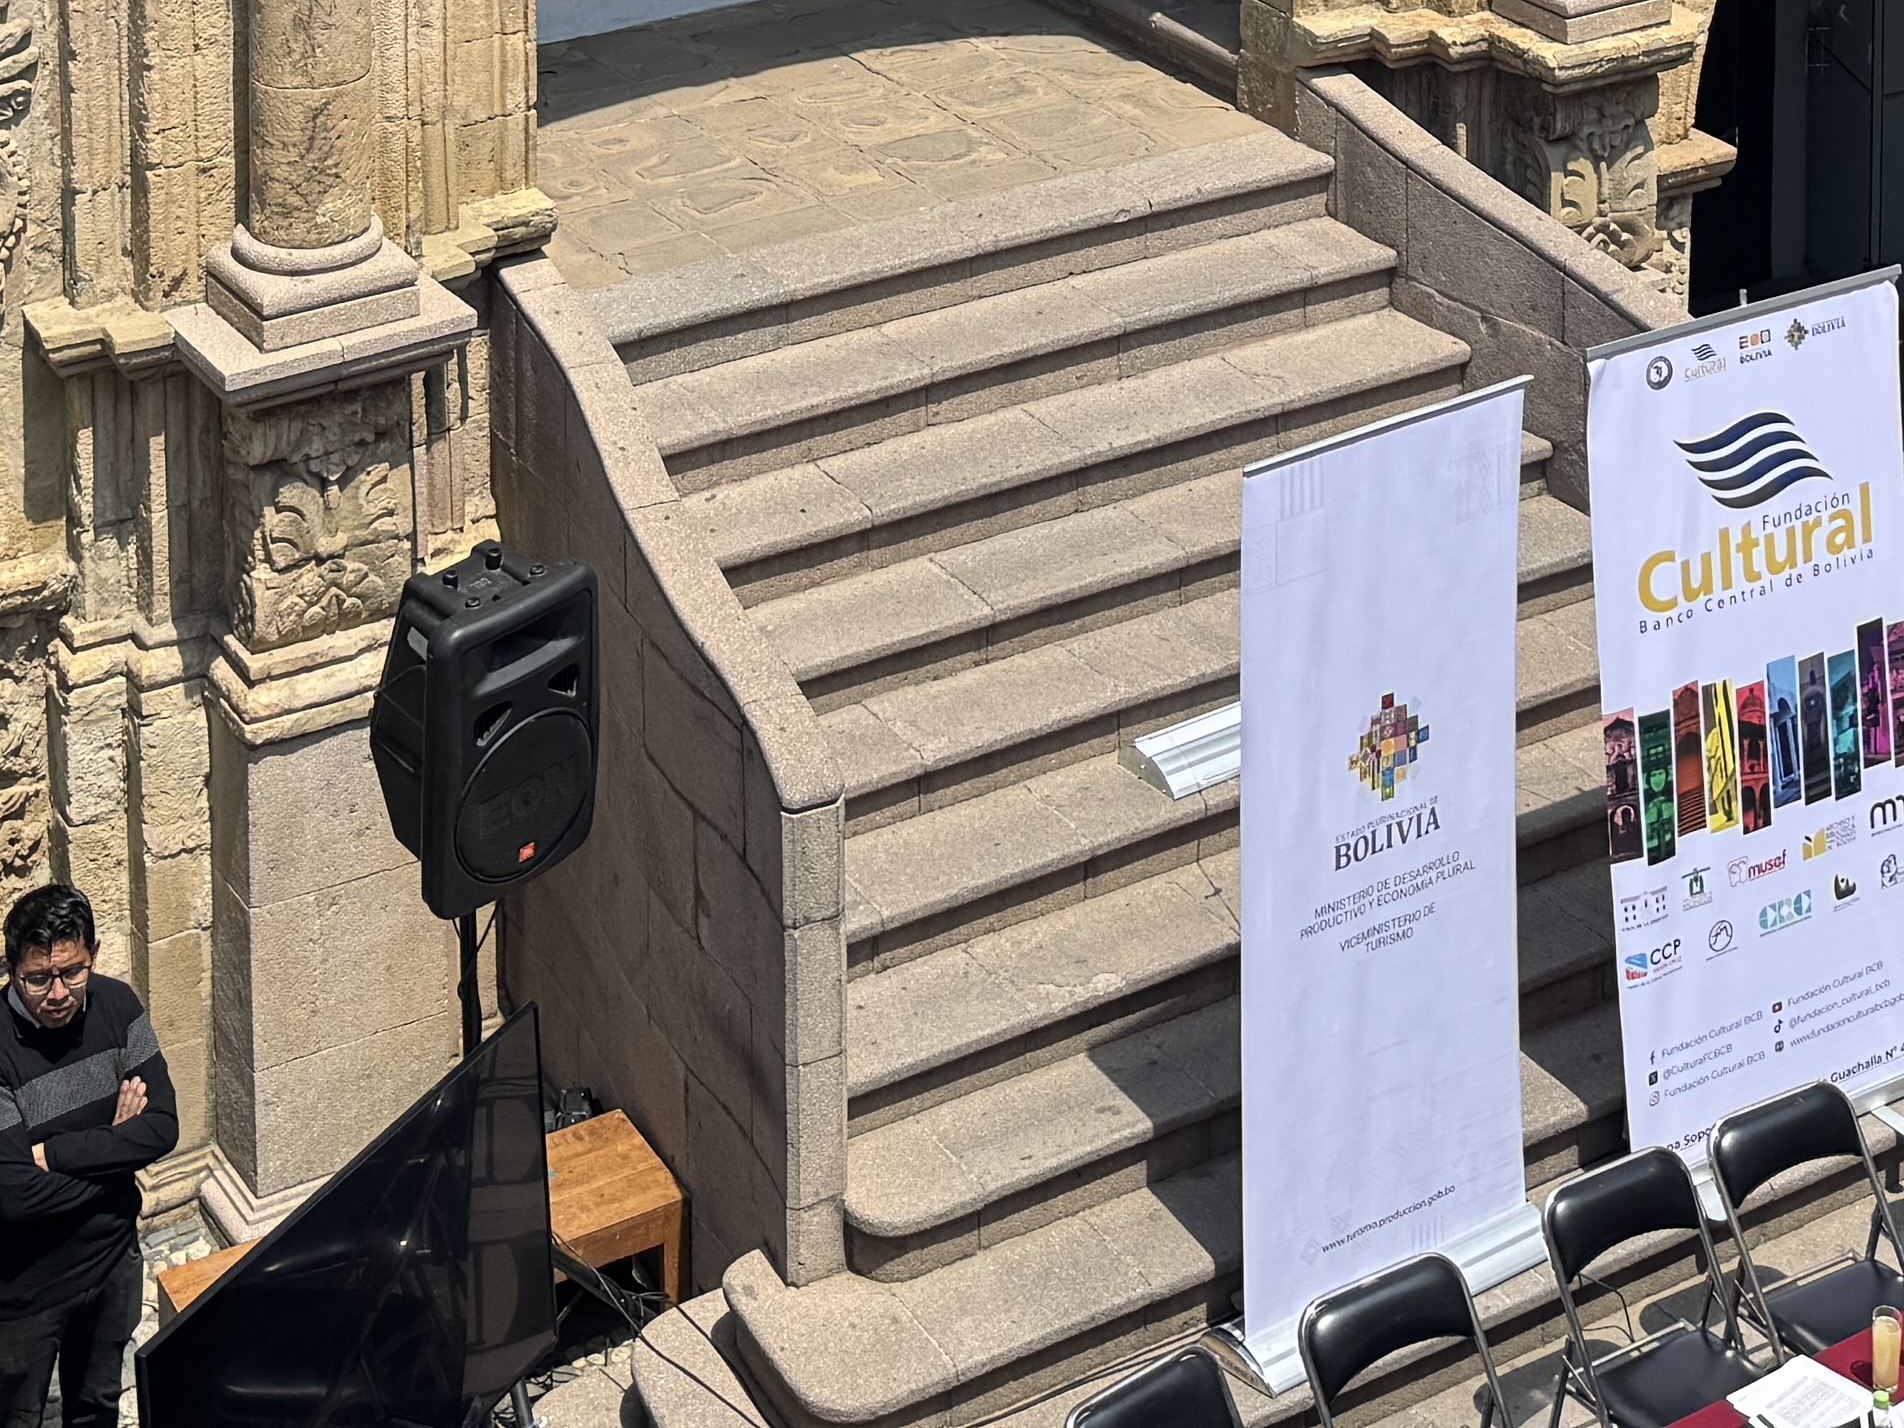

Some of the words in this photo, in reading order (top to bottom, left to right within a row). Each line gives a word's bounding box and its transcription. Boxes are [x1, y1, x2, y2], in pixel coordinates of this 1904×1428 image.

[1762, 492, 1851, 532] Fundación
[1638, 481, 1873, 614] Cultural
[1639, 608, 1694, 634] Banco
[1704, 579, 1774, 613] Central
[1784, 571, 1803, 588] de
[1812, 547, 1874, 578] Bolivia
[1334, 805, 1441, 872] BOLIVIA
[1300, 903, 1366, 941] PRODUCTIVO
[1368, 898, 1375, 910] Y
[1435, 860, 1476, 884] PLURAL
[1314, 884, 1375, 919] MINISTERIO
[1376, 878, 1391, 892] DE
[1394, 850, 1460, 887] DESARROLLO
[1339, 910, 1422, 952] VICEMINISTERIO
[1423, 901, 1436, 916] DE
[1365, 926, 1414, 953] TURISMO
[1650, 938, 1681, 965] CCP
[1786, 984, 1831, 1008] Fundación
[1832, 968, 1864, 988] Cultural
[1661, 1033, 1708, 1058] Fundación
[1708, 1019, 1743, 1039] Cultural
[1664, 1073, 1710, 1099] Fundación
[1710, 1059, 1745, 1080] Cultural
[1830, 1053, 1883, 1084] Guachalla
